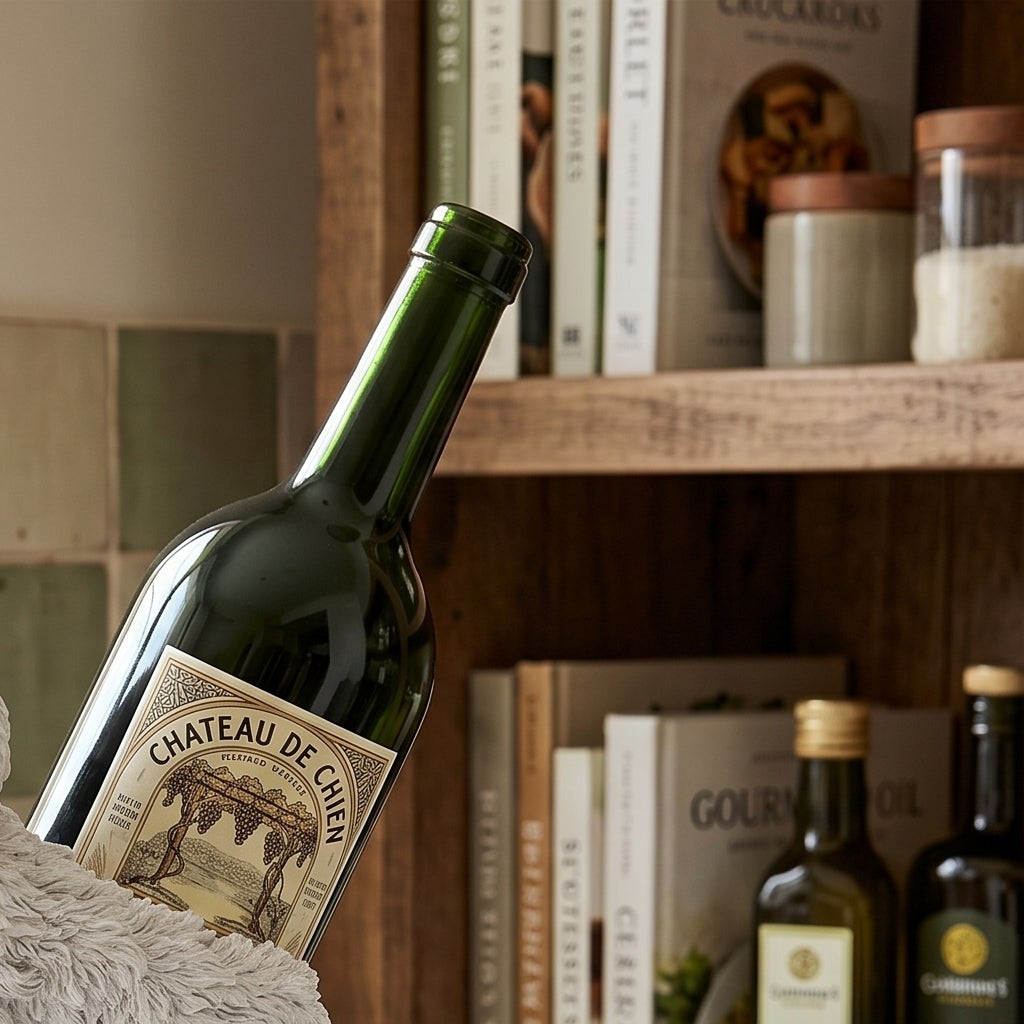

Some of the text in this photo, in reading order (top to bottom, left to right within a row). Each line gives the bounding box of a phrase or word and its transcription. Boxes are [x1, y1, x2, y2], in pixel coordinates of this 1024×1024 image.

[149, 715, 276, 765] CHATEAU
[280, 731, 318, 768] DE
[313, 764, 345, 844] CHIEN
